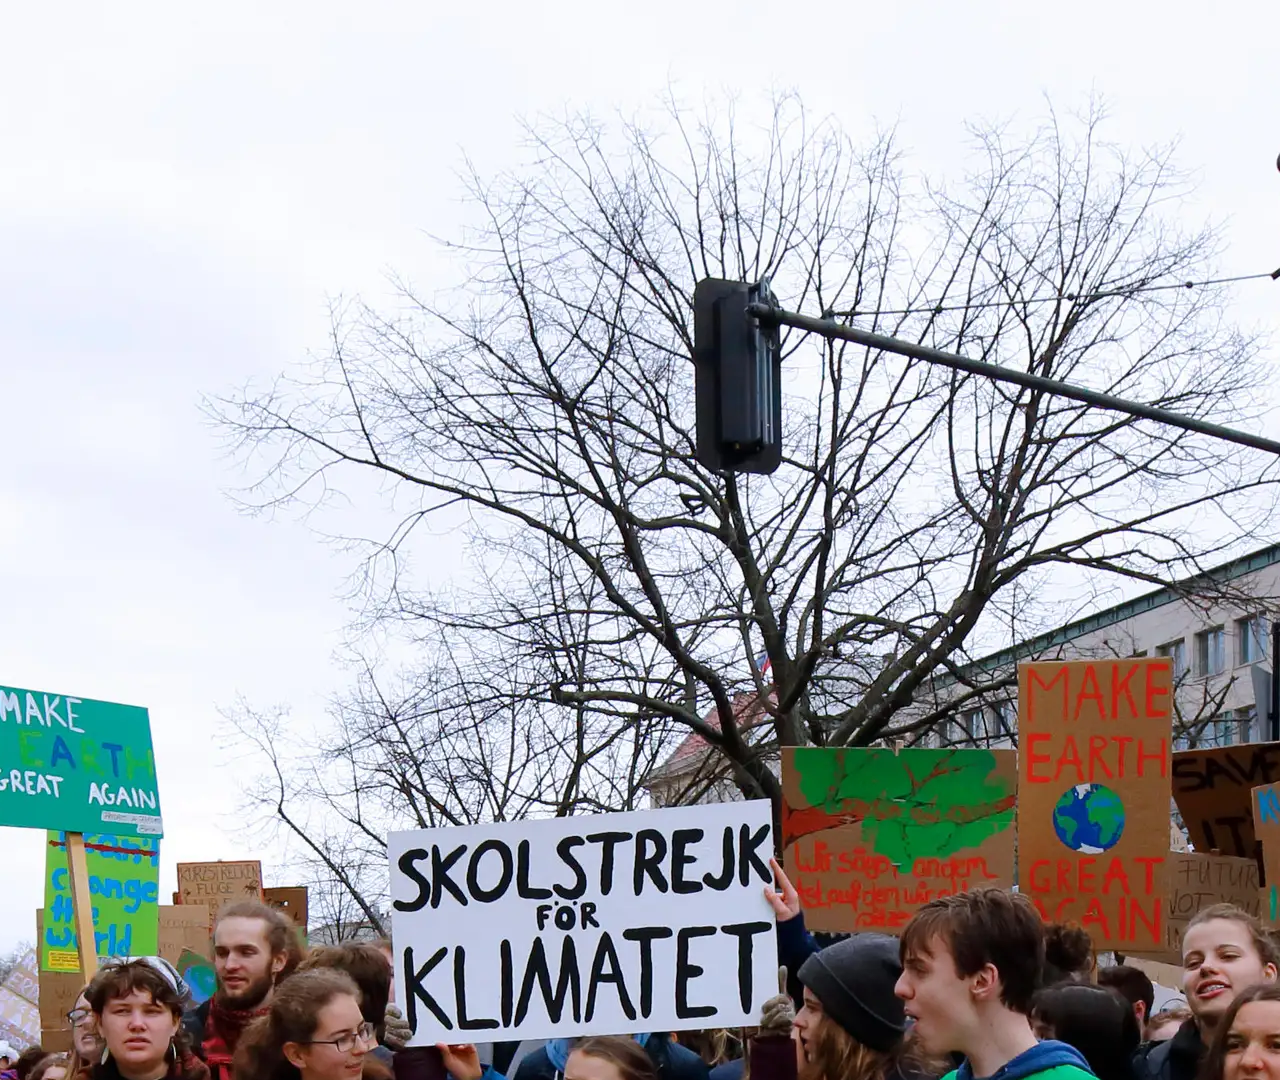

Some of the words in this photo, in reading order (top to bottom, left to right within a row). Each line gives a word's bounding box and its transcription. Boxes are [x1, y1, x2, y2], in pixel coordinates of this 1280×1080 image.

[1027, 664, 1169, 722] MAKE
[19, 729, 156, 781] EARTH
[1027, 733, 1167, 783] EARTH
[88, 782, 156, 809] AGAIN
[393, 824, 773, 912] SKOLSTREJK
[795, 841, 832, 874] Wir
[1029, 857, 1164, 896] GREAT
[1178, 860, 1259, 891] FUTUR
[537, 901, 600, 931] FÖR
[46, 923, 132, 957] wrld
[404, 921, 773, 1036] KLIMATET
